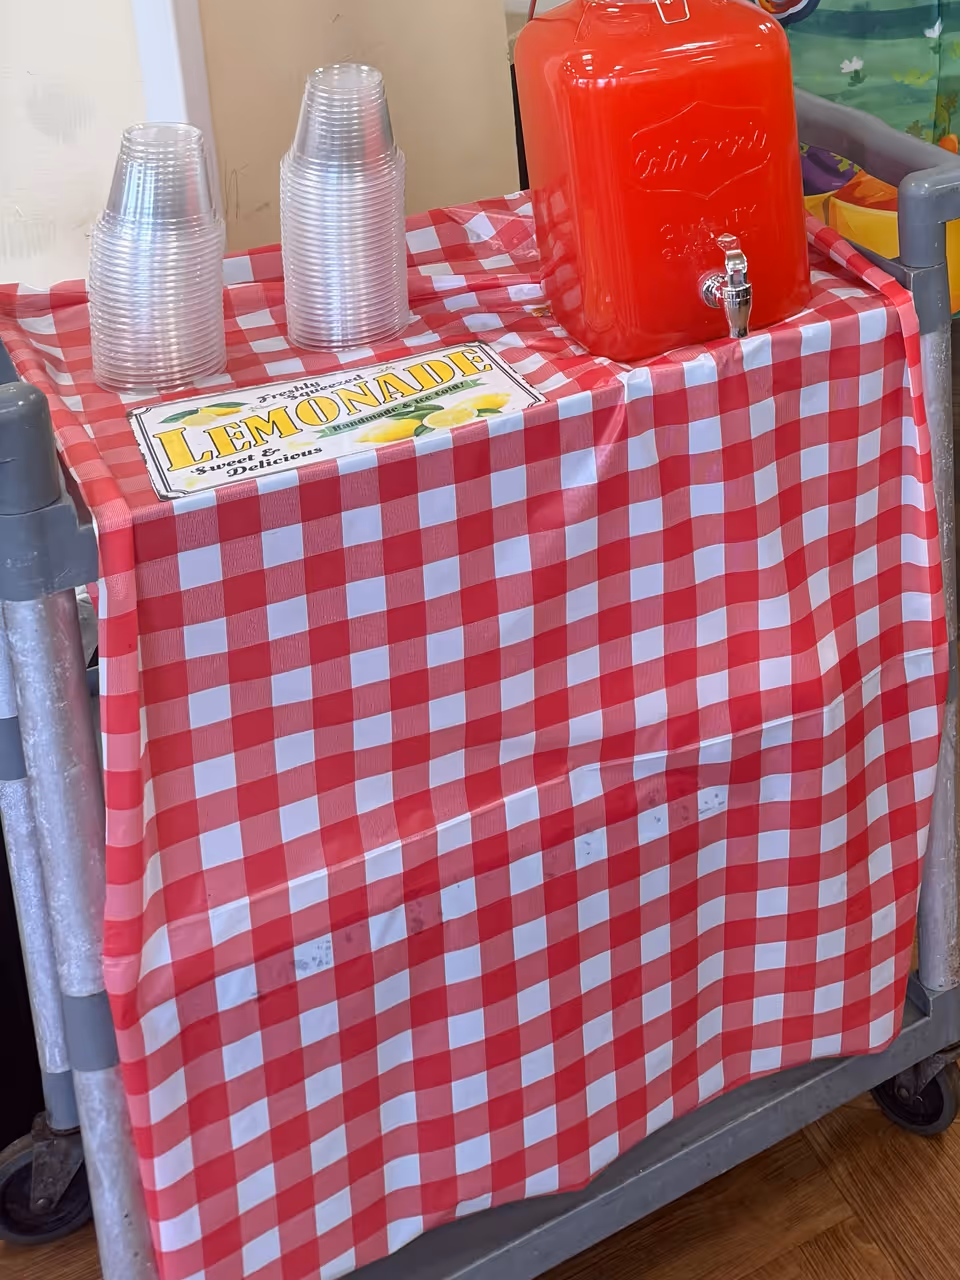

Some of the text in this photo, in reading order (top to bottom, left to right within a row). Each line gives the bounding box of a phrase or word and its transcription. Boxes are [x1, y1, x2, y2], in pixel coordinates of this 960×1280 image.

[256, 380, 321, 403] Freshly
[284, 373, 366, 401] Squeezed
[151, 347, 493, 473] LEMONADE
[331, 405, 399, 432] Handmade
[401, 401, 413, 410] &
[415, 394, 434, 405] Ice
[190, 447, 281, 476] Sweet &
[226, 446, 323, 478] Delicious
